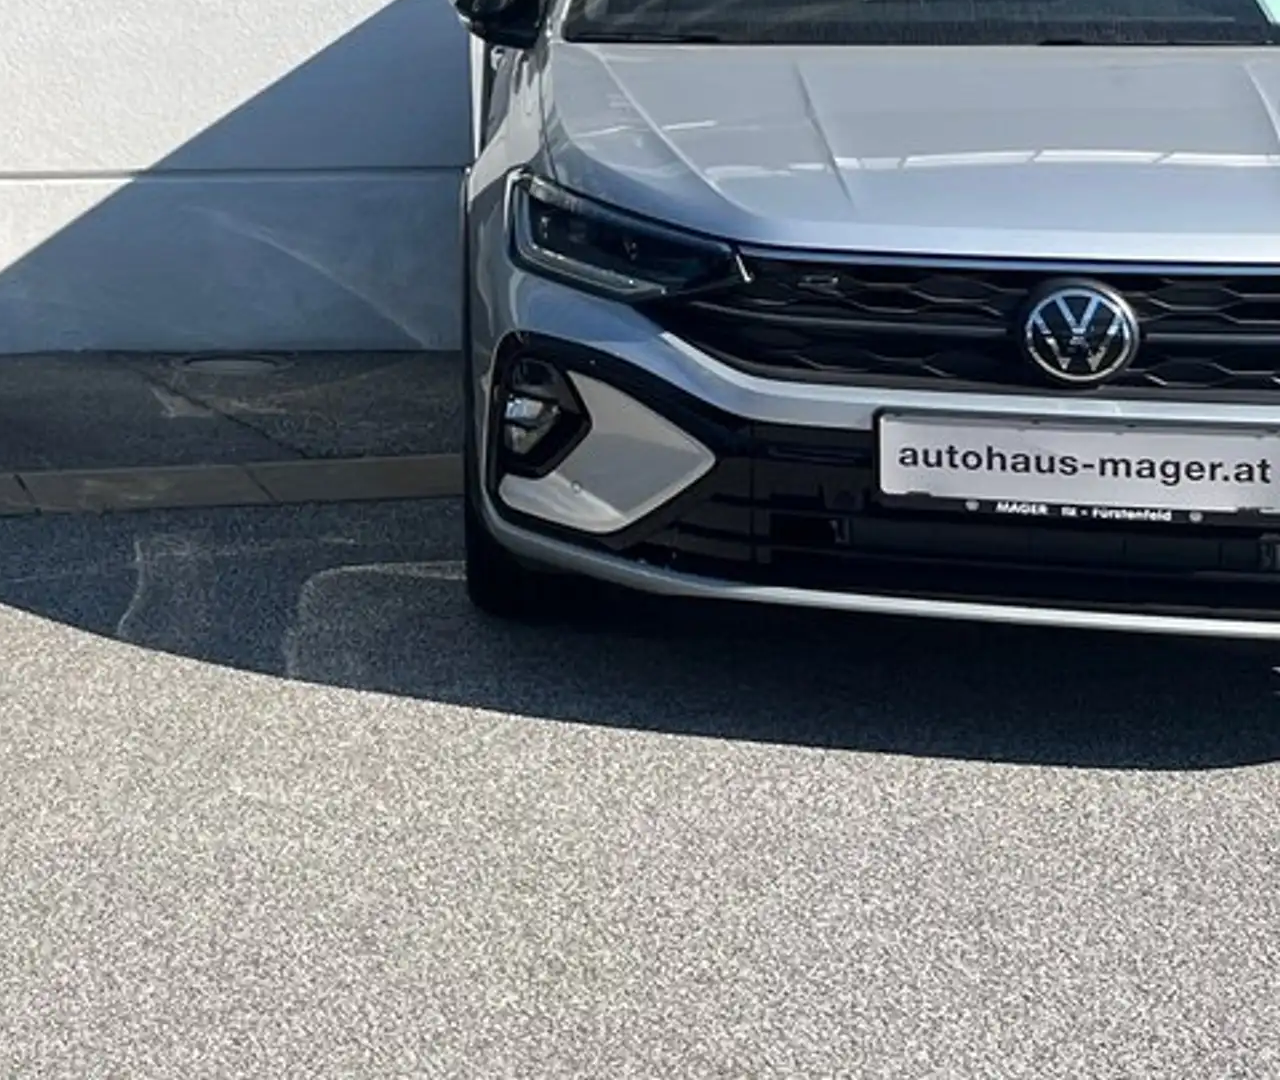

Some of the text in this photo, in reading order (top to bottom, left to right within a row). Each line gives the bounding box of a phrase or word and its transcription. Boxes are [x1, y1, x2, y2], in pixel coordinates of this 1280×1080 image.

[898, 445, 1272, 486] autohaus-mager.at
[995, 501, 1049, 516] MAGER
[1092, 506, 1172, 522] Fürstenfeld
